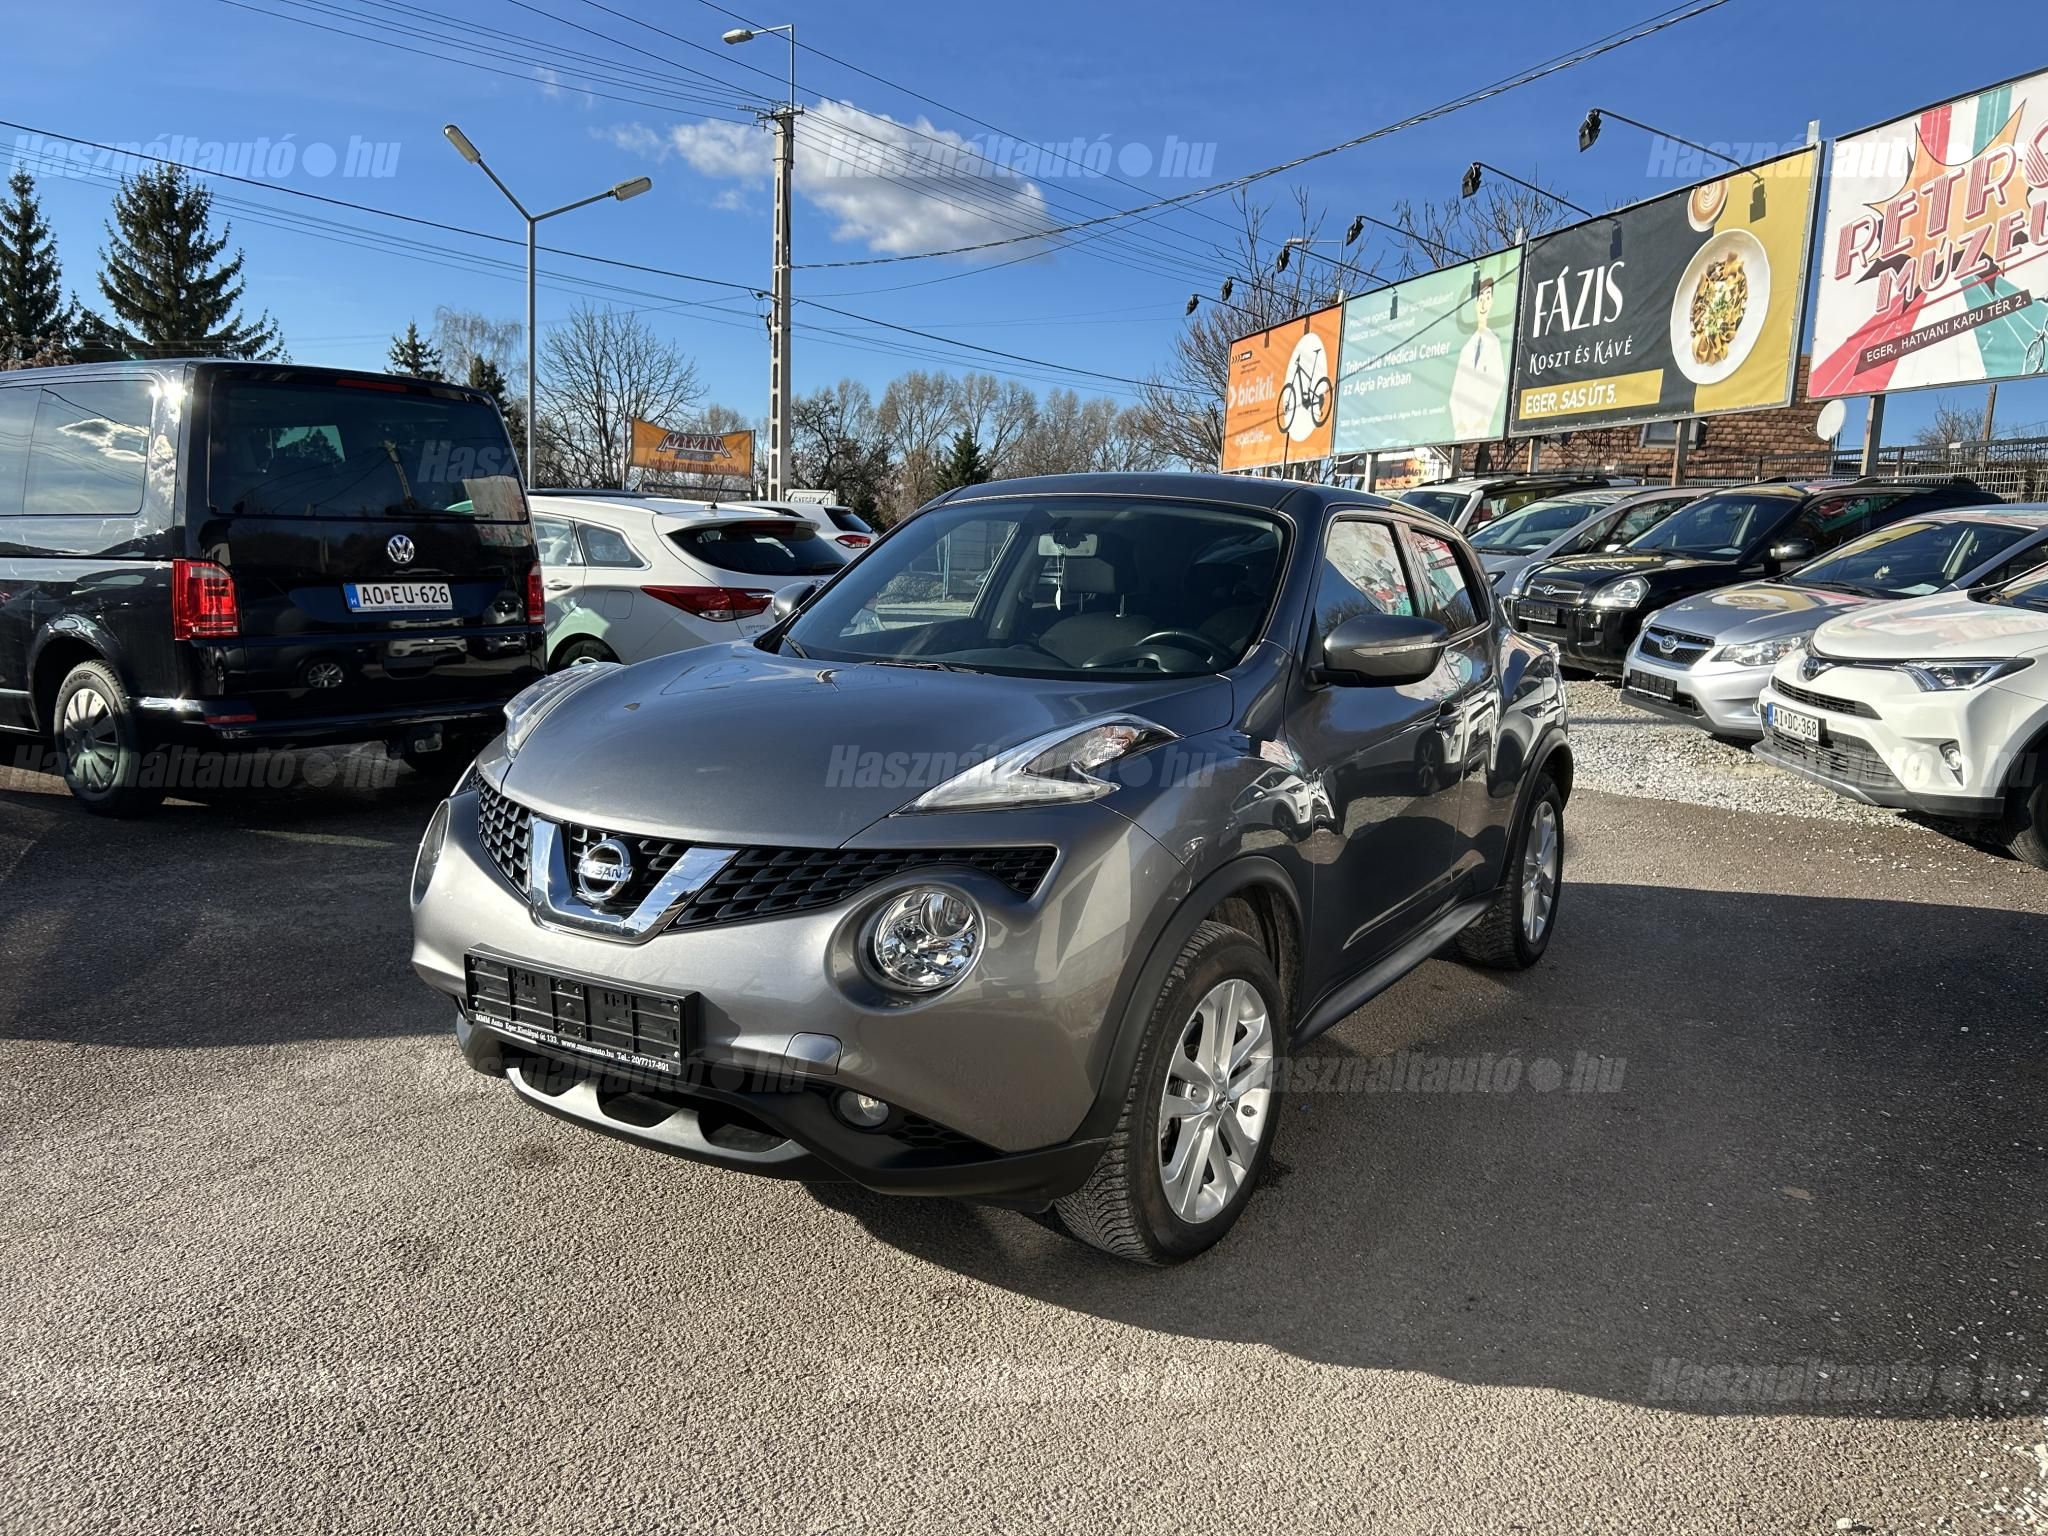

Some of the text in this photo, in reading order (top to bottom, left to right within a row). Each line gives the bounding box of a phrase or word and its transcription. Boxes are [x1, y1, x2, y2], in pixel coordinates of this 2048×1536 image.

[1532, 261, 1625, 338] FÁZIS
[1866, 295, 2027, 363] EGER, HATVANI KAPU TÉR 2.
[1384, 346, 1417, 367] Medical
[1420, 342, 1451, 357] Center
[1574, 344, 1590, 365] ÉS
[1354, 377, 1375, 395] Agria
[1377, 373, 1412, 390] Parkban
[1525, 382, 1618, 415] EGER, SAS ÚT 5.
[656, 432, 732, 458] MMM
[391, 586, 449, 604] EU-626
[475, 1013, 490, 1025] MMM
[631, 1055, 669, 1071] 20/7717-891
